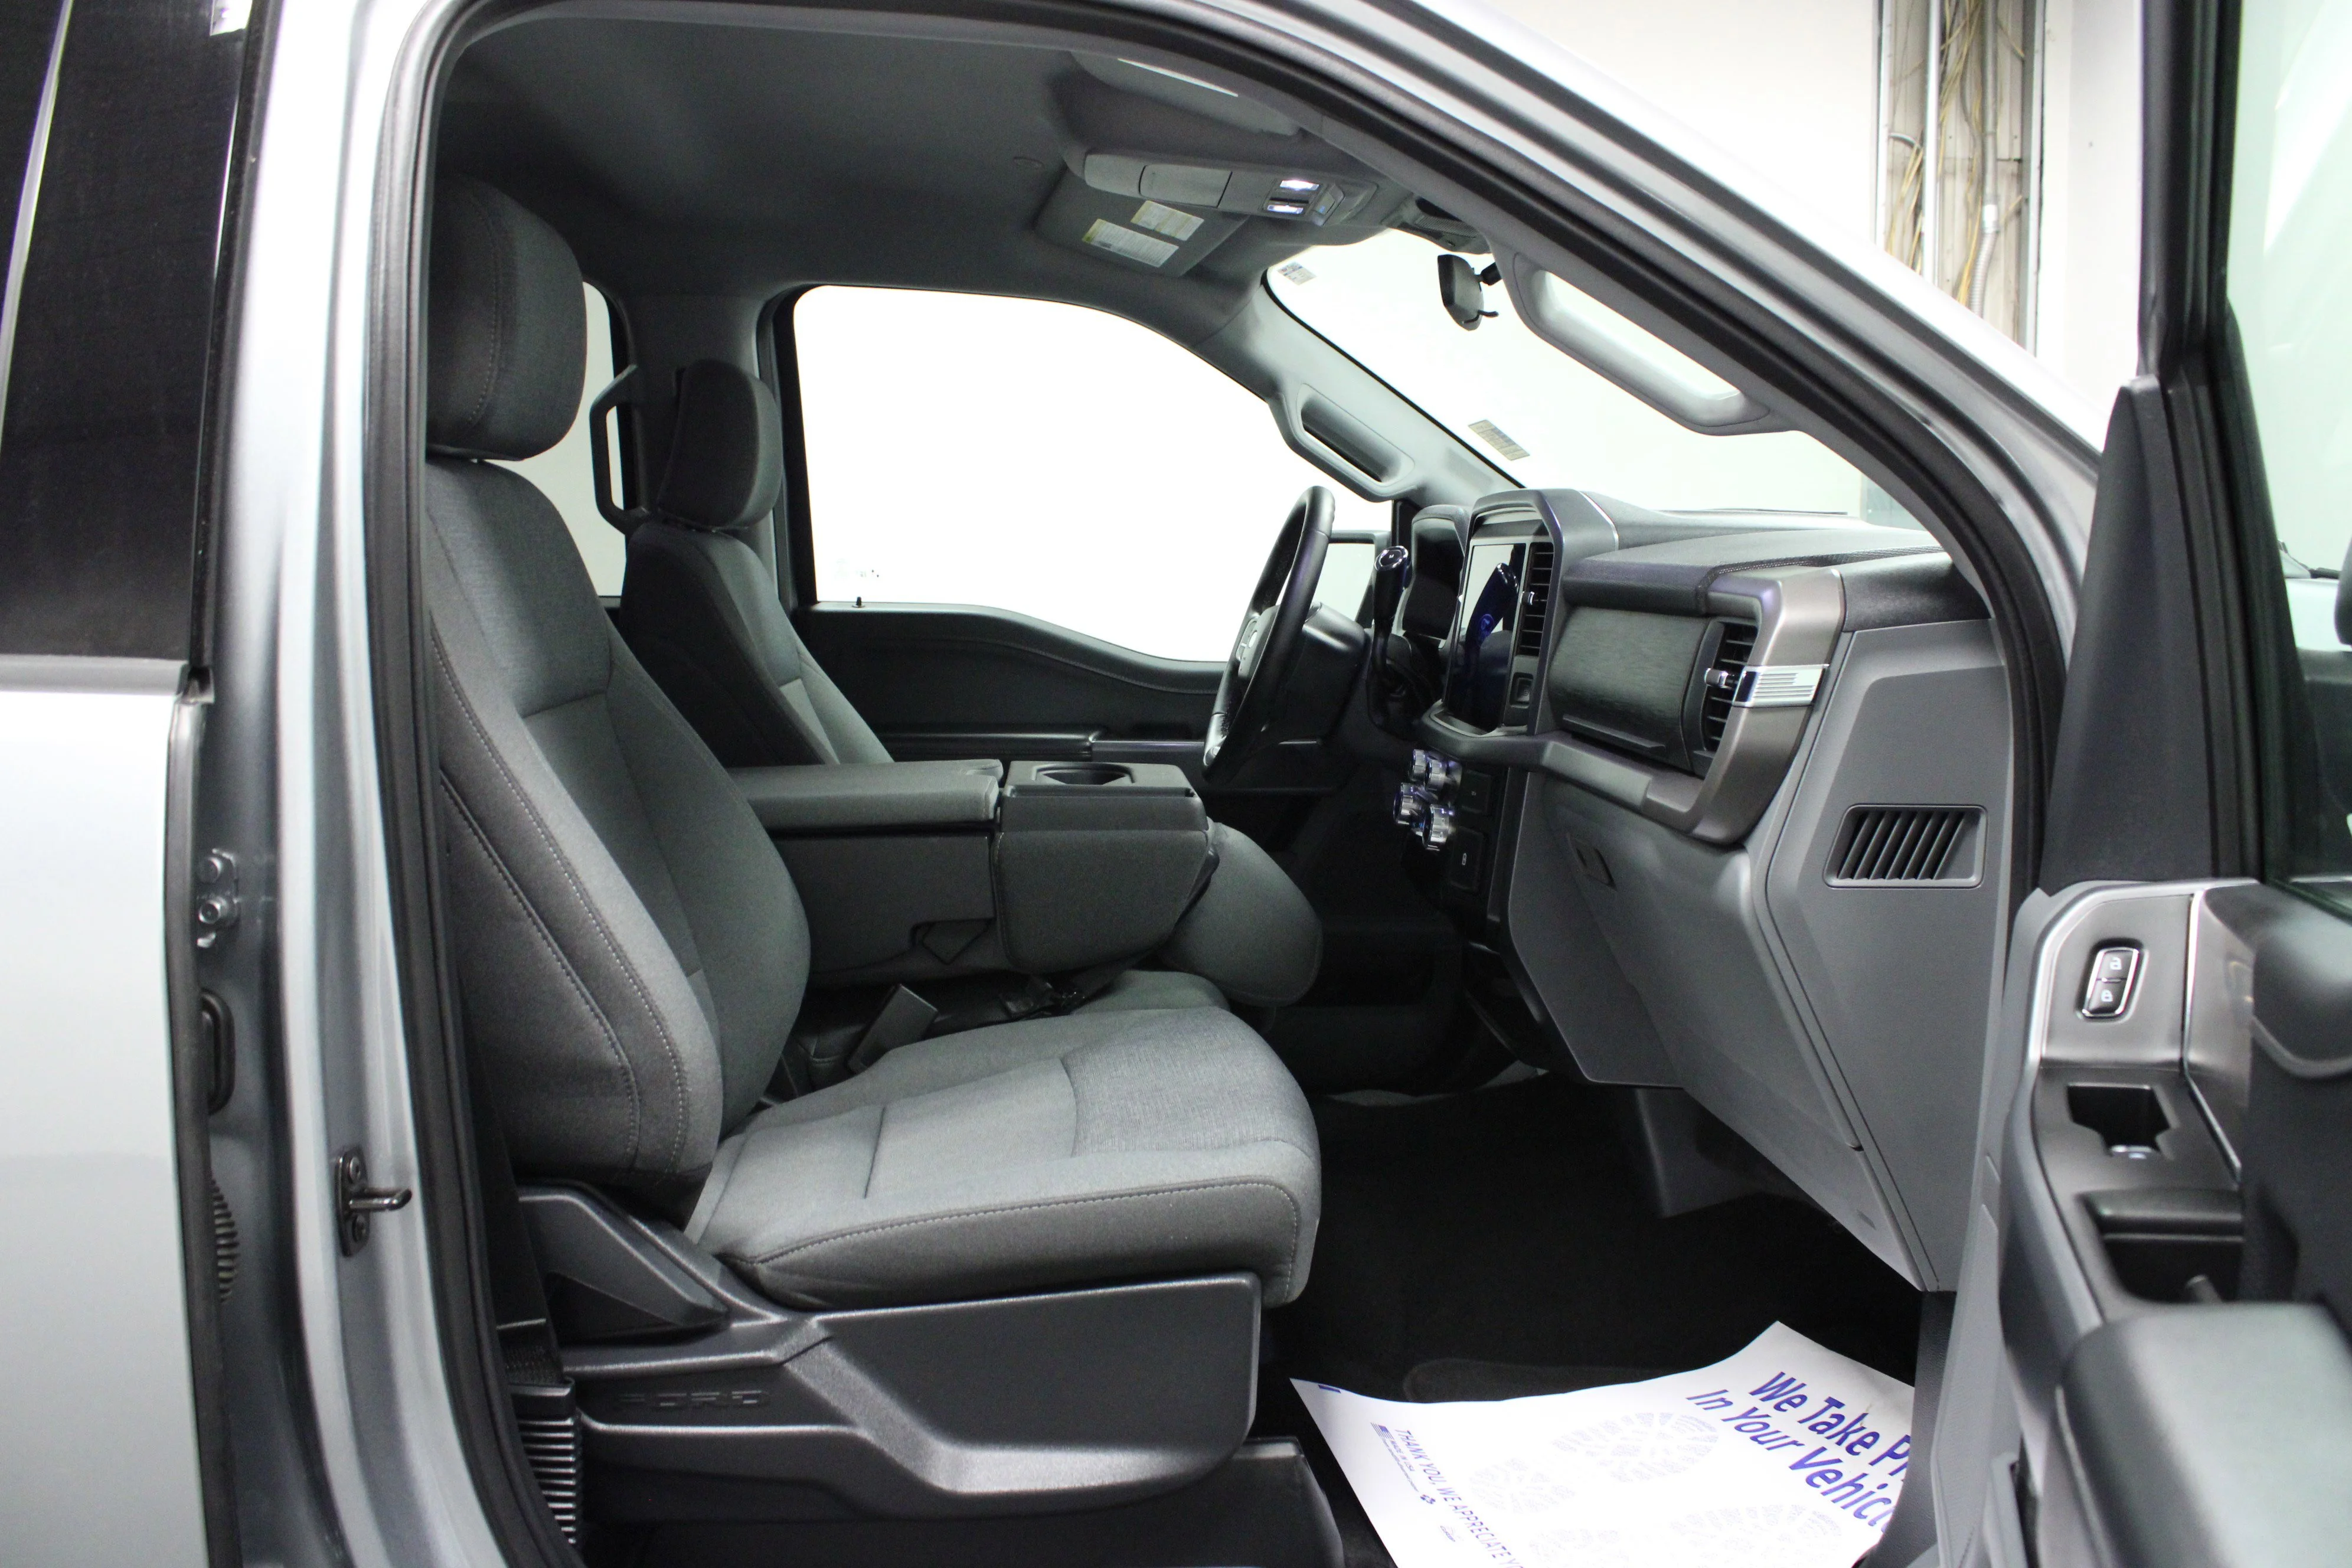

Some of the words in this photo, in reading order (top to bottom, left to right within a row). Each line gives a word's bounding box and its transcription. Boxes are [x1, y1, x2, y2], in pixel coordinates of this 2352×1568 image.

[615, 1389, 770, 1412] FORD
[1748, 1371, 1808, 1412] We
[1797, 1396, 1880, 1456] Take
[1685, 1389, 1733, 1410] In
[1720, 1406, 1805, 1451] Your
[1394, 1429, 1430, 1461] THANK
[1419, 1463, 1447, 1485] YOU,
[1436, 1487, 1463, 1502] WE
[1449, 1504, 1511, 1559] APPRECIATE
